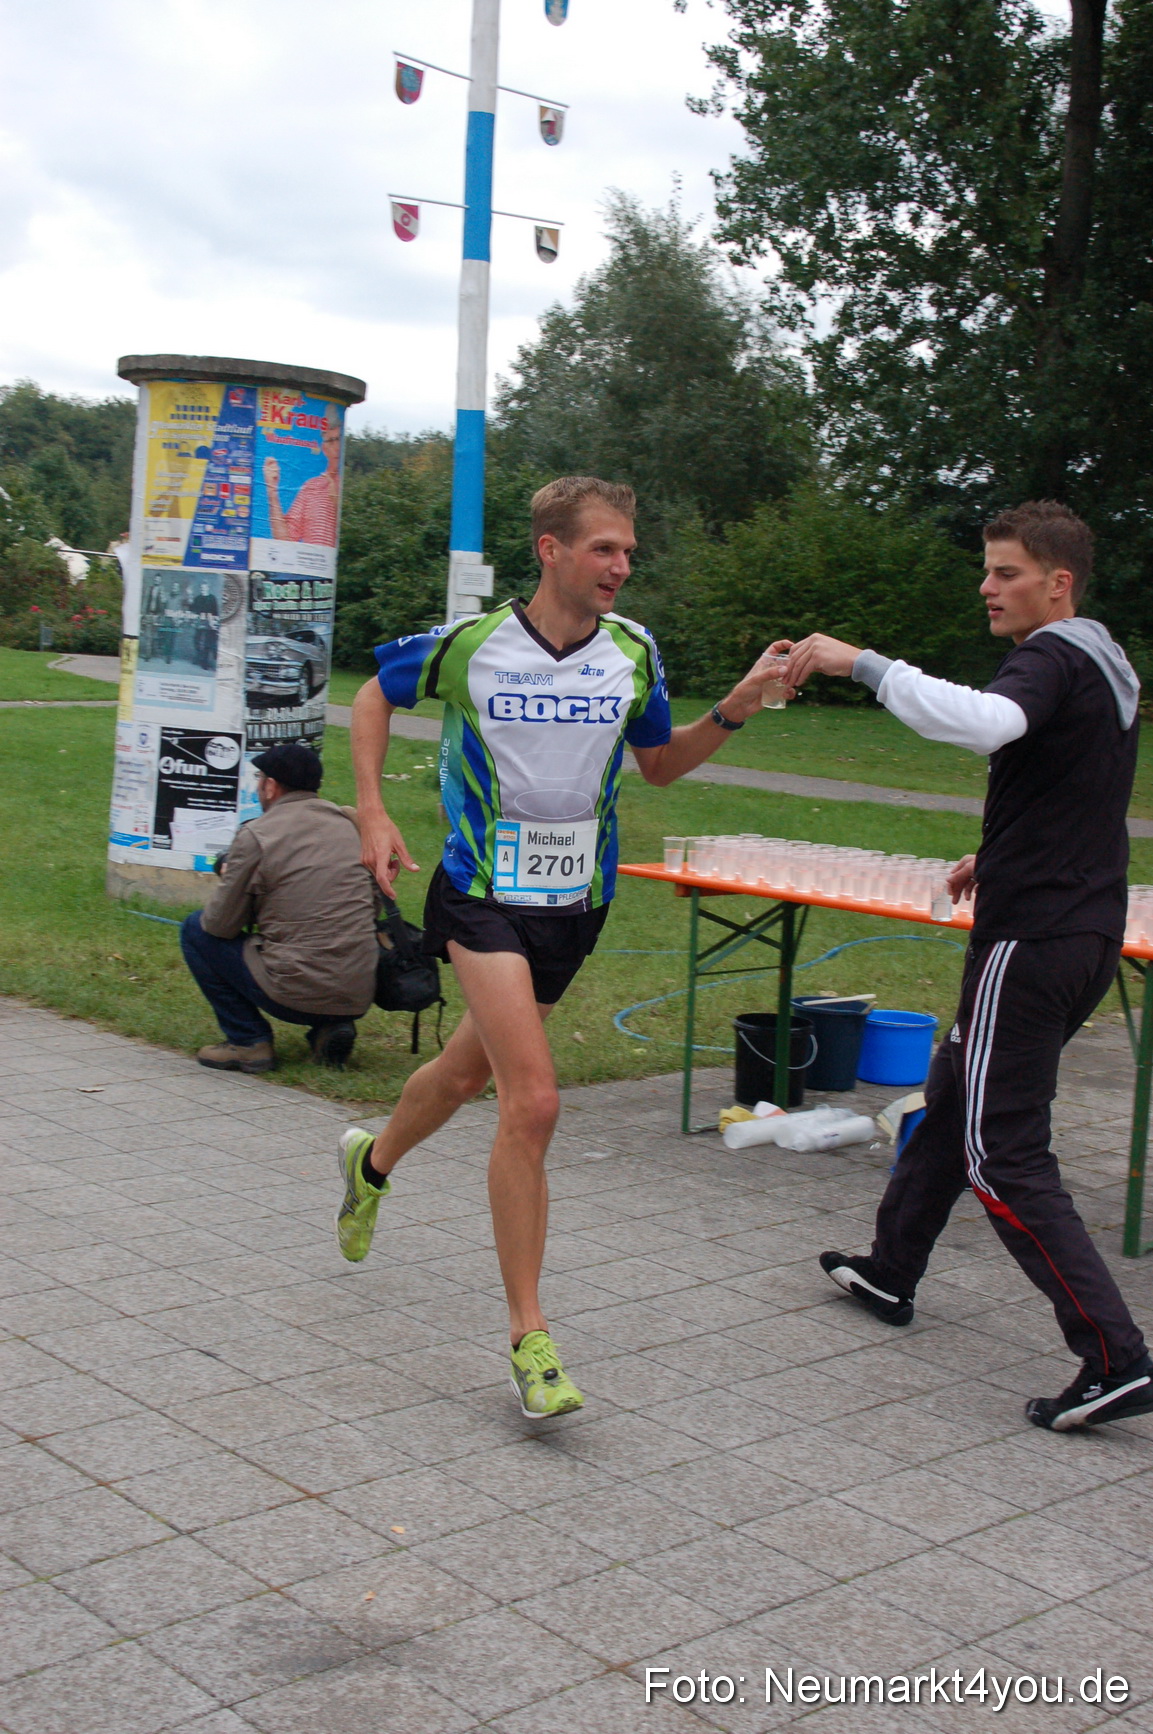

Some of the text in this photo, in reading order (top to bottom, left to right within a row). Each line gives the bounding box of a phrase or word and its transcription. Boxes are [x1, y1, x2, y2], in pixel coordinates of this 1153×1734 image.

[270, 405, 330, 431] Kraus
[495, 671, 553, 686] TEAM
[488, 692, 622, 724] BOCK
[527, 830, 575, 846] Michael
[502, 851, 509, 862] A
[527, 853, 585, 877] 2701
